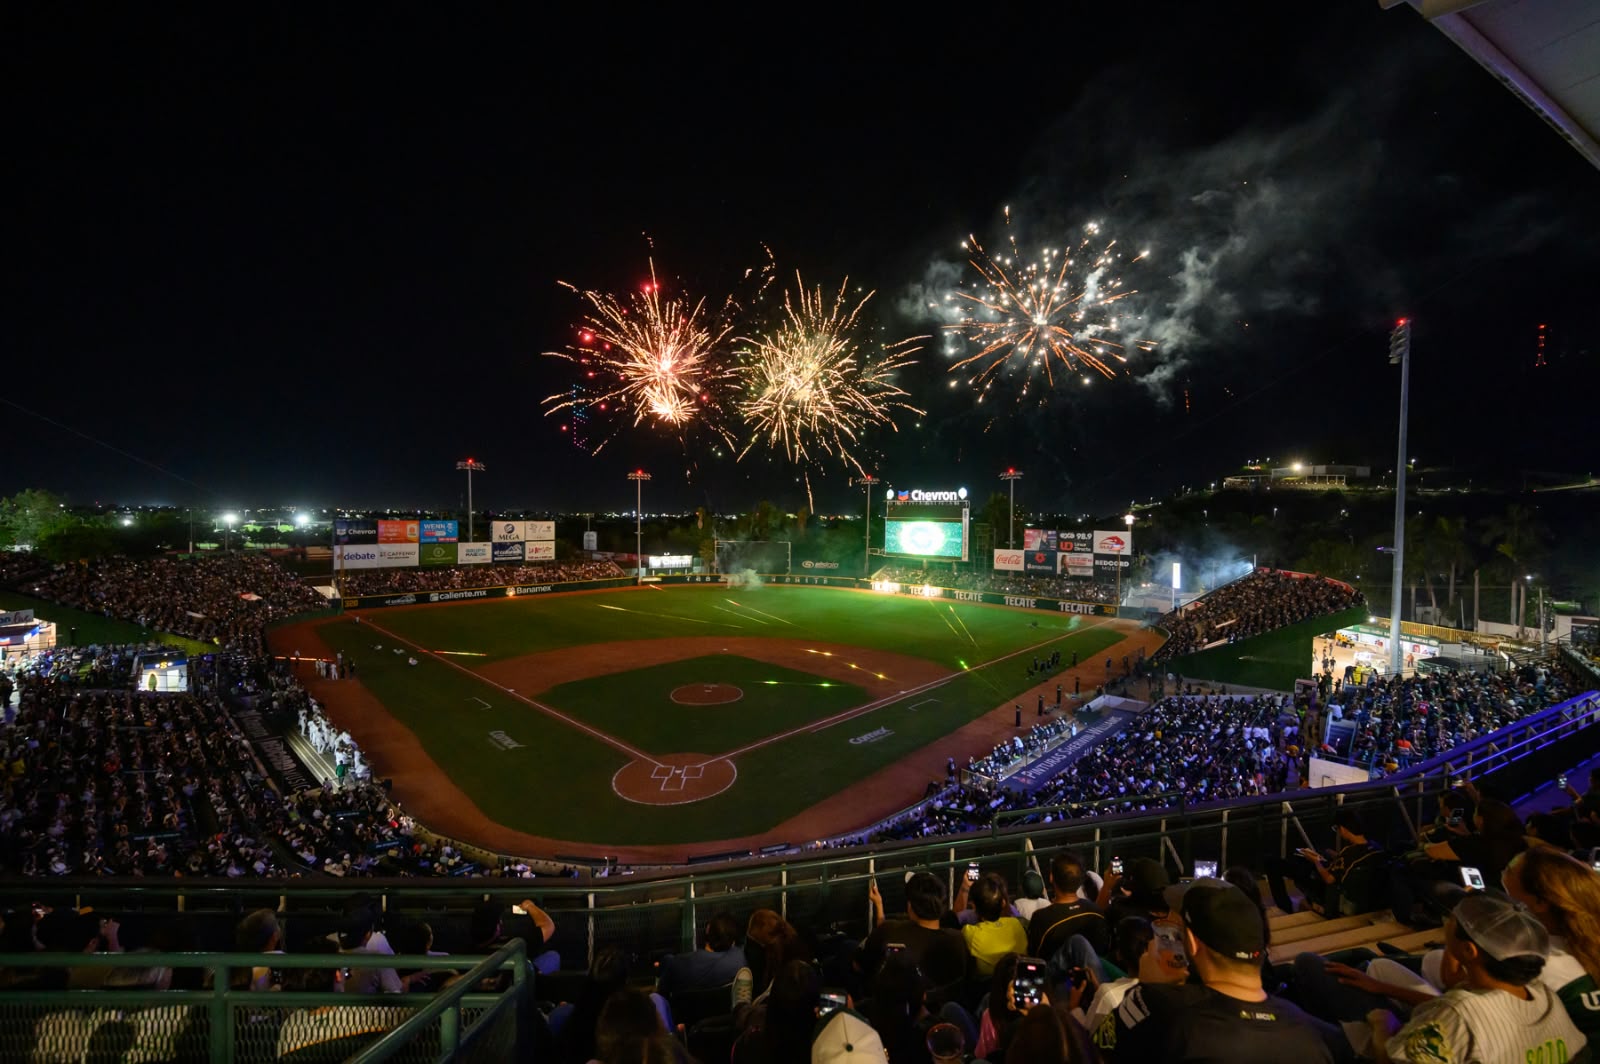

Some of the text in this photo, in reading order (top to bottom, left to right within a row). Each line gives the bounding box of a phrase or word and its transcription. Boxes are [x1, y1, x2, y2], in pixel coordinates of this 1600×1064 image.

[911, 489, 957, 500] Chevron
[1075, 532, 1092, 540] 98.9
[344, 551, 375, 561] debate
[439, 590, 487, 600] caliente.mx
[517, 585, 552, 594] Banamex
[954, 590, 983, 602] TECATE
[1003, 595, 1037, 608] TECATE
[1058, 602, 1095, 615] TECATE
[1027, 752, 1067, 779] PINTURAS
